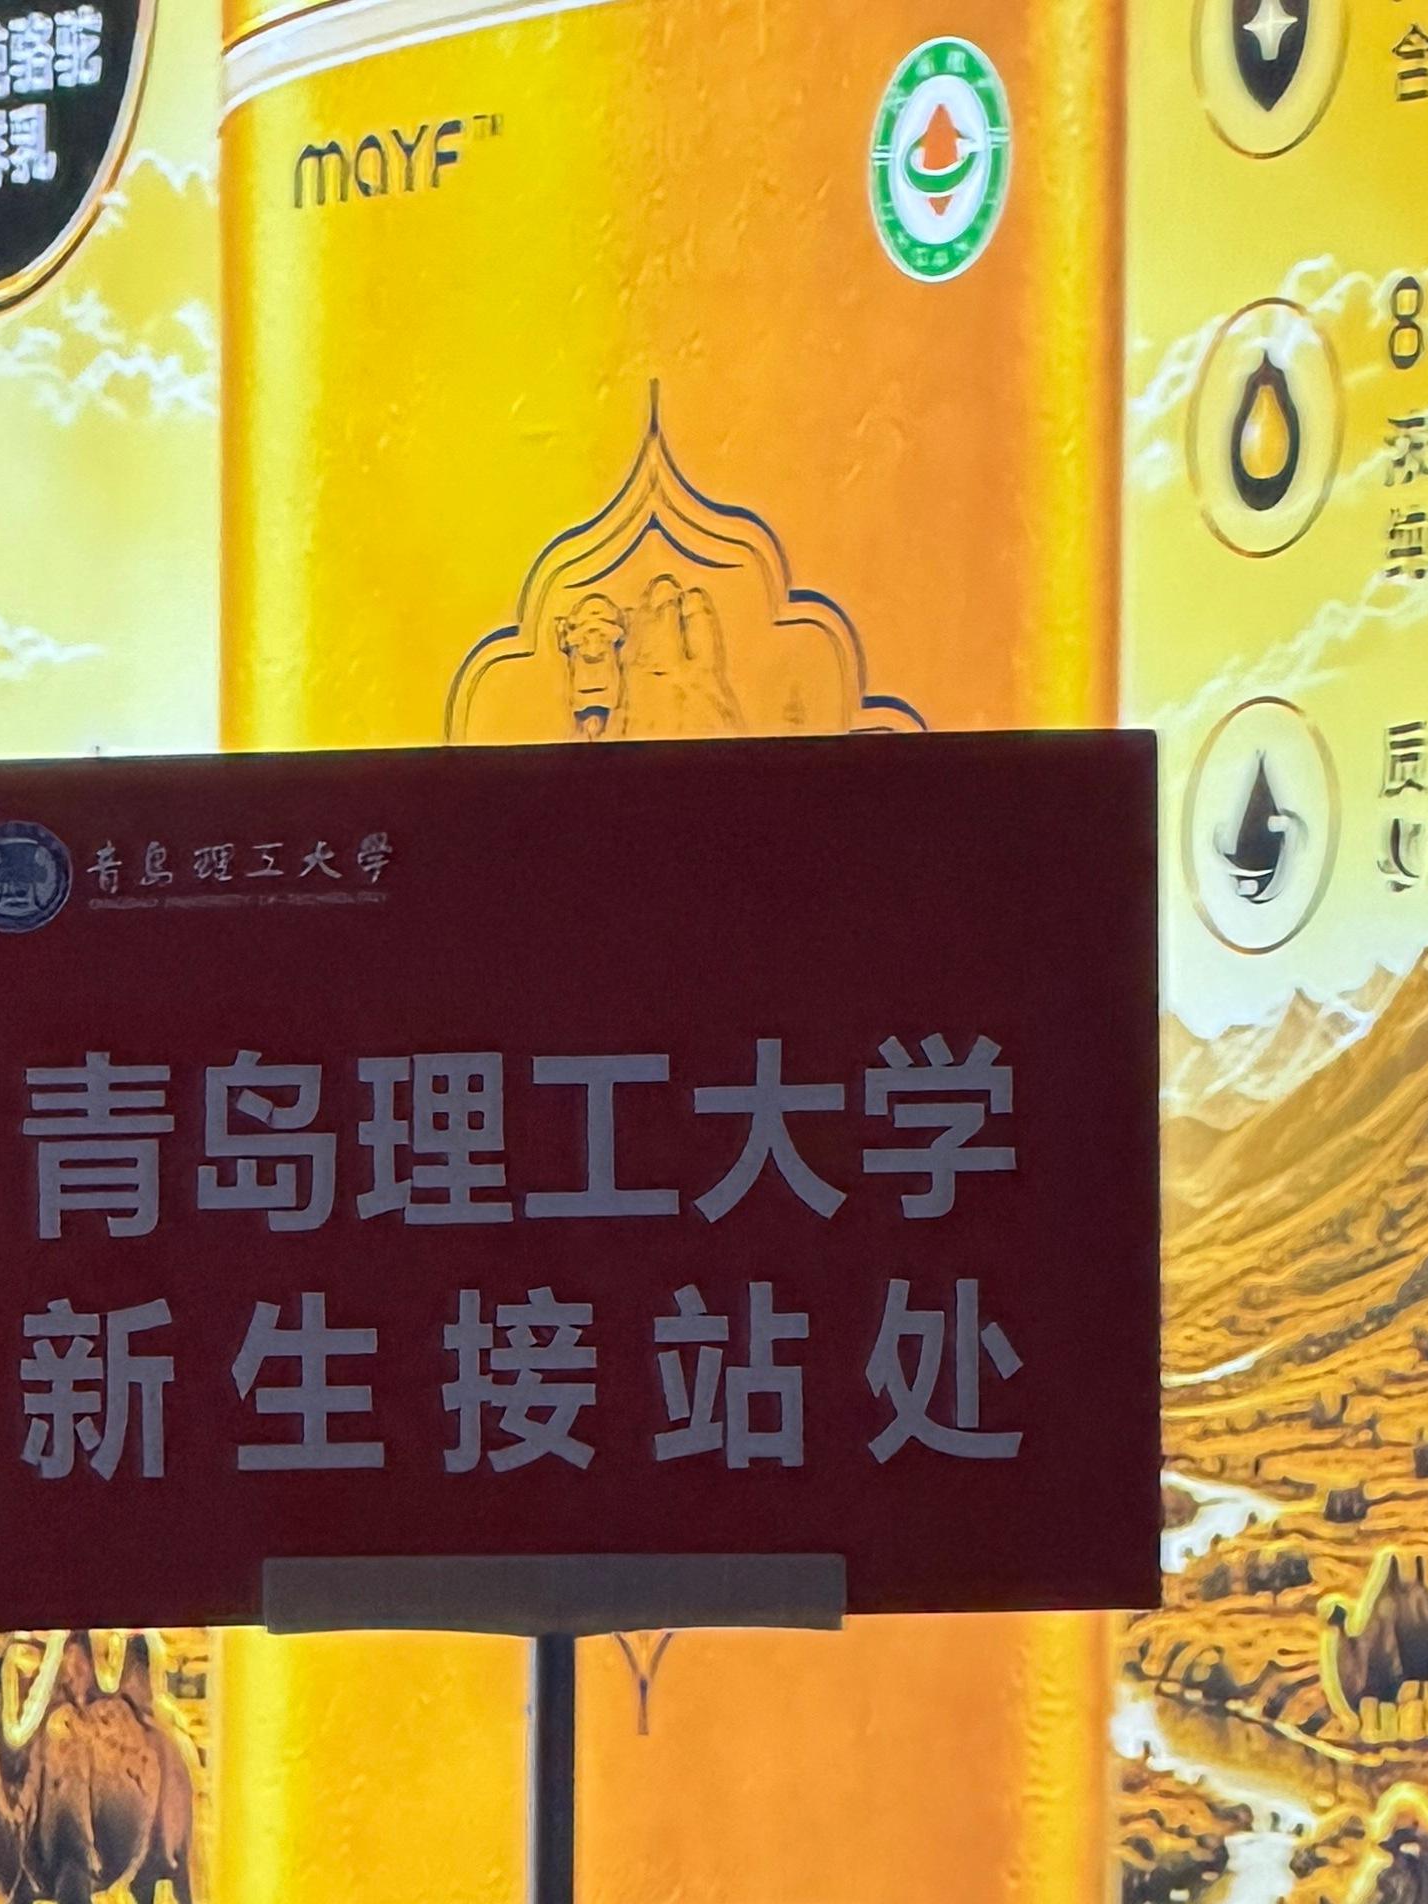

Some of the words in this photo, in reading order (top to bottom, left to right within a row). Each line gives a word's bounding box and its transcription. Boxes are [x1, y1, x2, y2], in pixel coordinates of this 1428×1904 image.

[87, 831, 393, 894] 青岛理工大学
[21, 1031, 1017, 1241] 青岛理工大学
[20, 1277, 1024, 1484] 新生接站处
